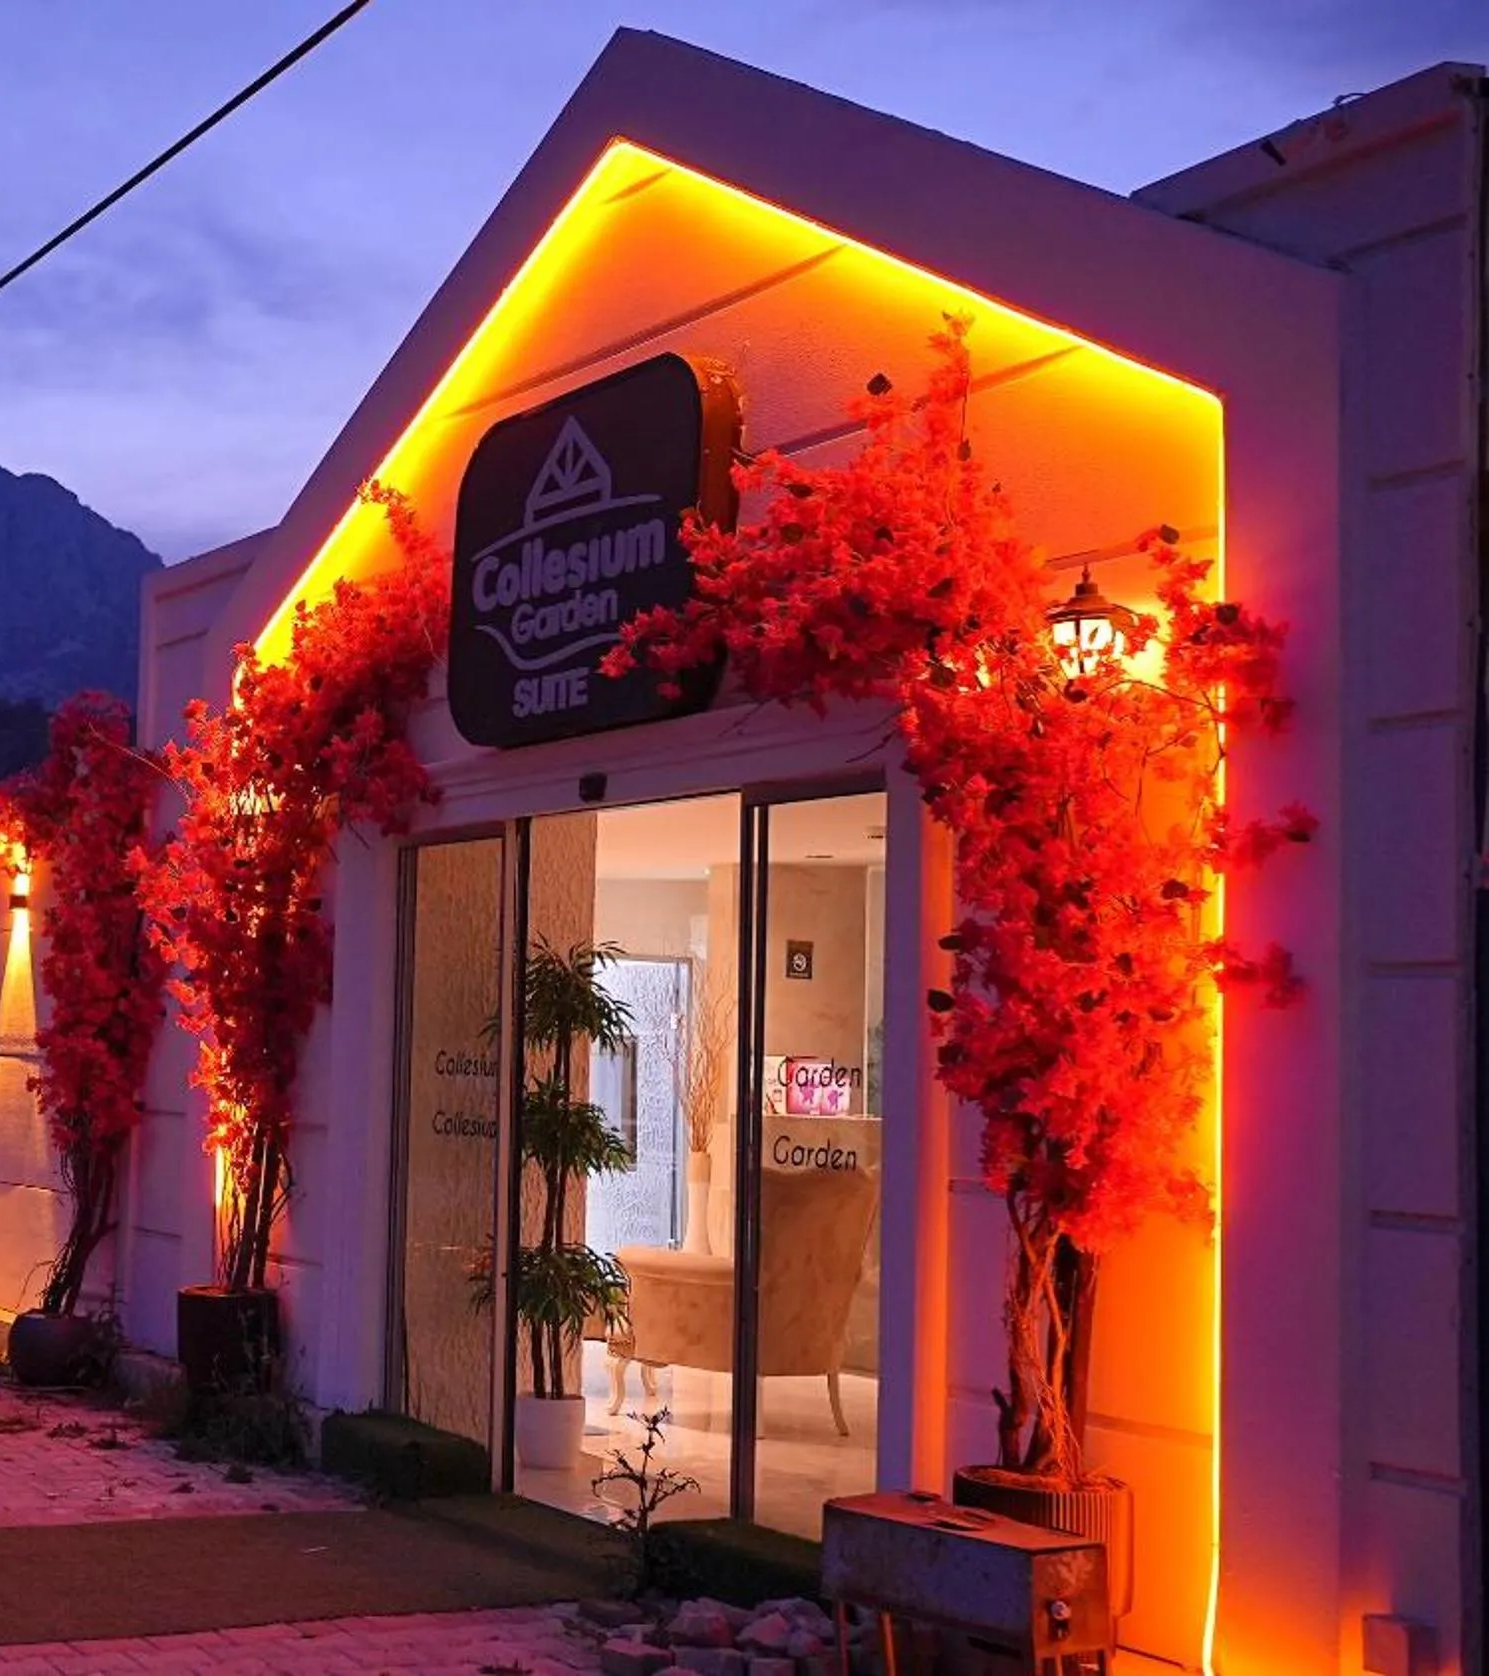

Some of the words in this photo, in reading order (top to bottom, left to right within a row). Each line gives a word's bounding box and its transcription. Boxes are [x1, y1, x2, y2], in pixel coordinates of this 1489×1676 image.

[473, 520, 665, 612] Collesium
[514, 589, 618, 644] Garden
[513, 668, 590, 718] SUITE
